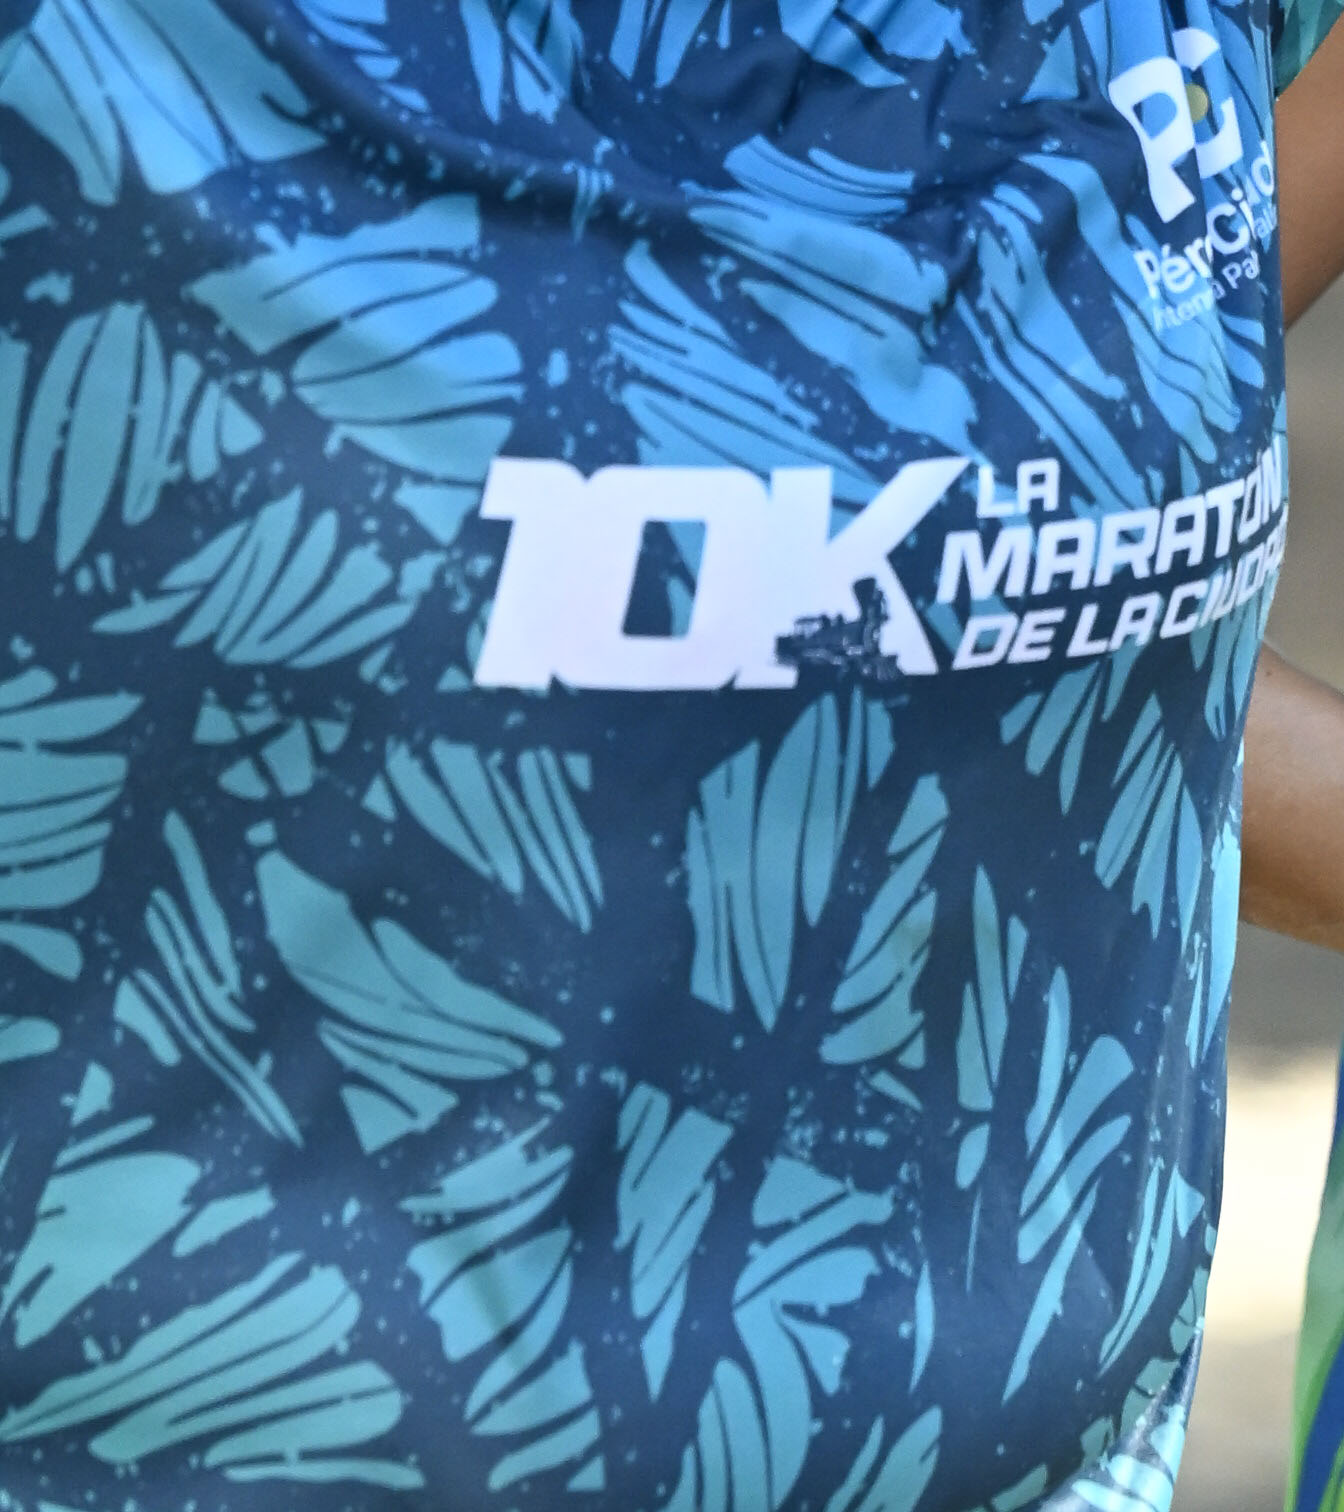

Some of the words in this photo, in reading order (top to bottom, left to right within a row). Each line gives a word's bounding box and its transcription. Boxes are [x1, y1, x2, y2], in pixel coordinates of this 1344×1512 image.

[475, 456, 973, 691] 10K
[977, 458, 1060, 518] LA
[952, 607, 1067, 671] DE
[1066, 592, 1164, 658] LA
